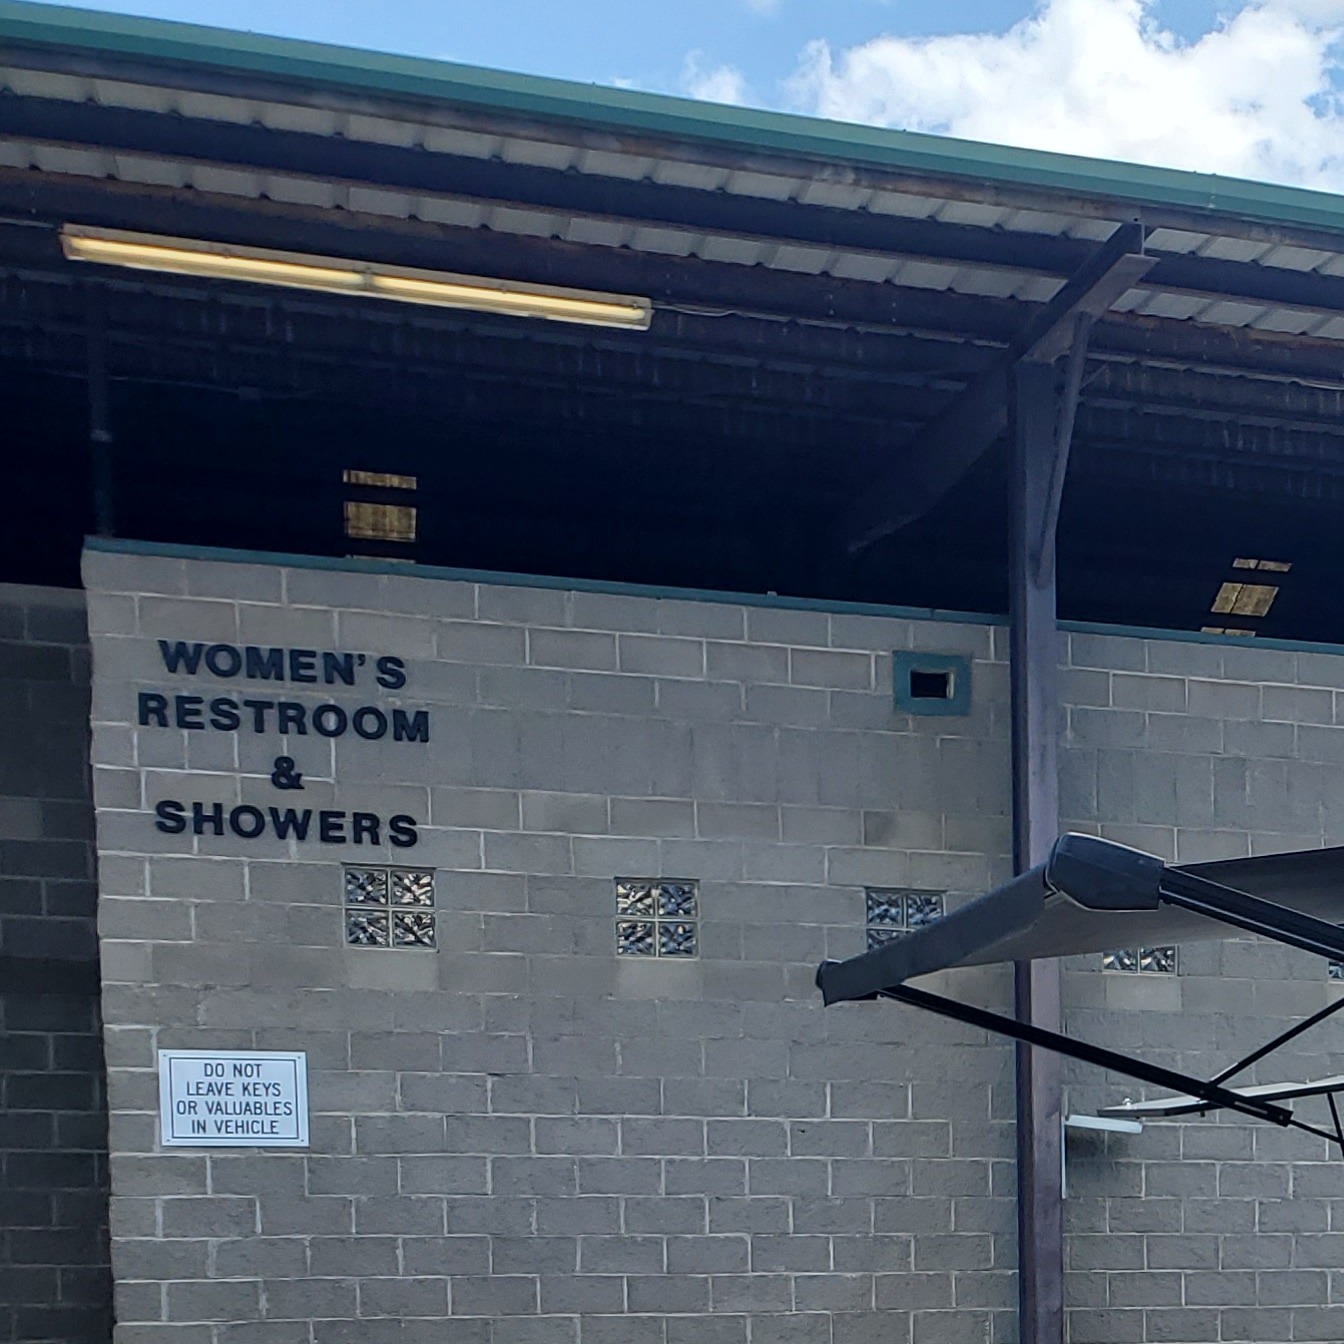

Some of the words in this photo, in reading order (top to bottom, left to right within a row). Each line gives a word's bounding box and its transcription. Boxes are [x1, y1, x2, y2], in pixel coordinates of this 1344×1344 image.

[157, 639, 407, 690] WOMEN'S
[138, 692, 430, 743] RESTROOM
[271, 756, 305, 790] &
[155, 800, 418, 848] SHOWERS
[204, 1062, 225, 1078] DO
[233, 1063, 262, 1078] NOT
[186, 1081, 235, 1097] LEAVE
[242, 1082, 281, 1097] KEYS
[176, 1100, 198, 1115] OR
[205, 1100, 293, 1116] VALUABLES
[191, 1119, 207, 1134] IN
[214, 1120, 280, 1135] VEHICLE
